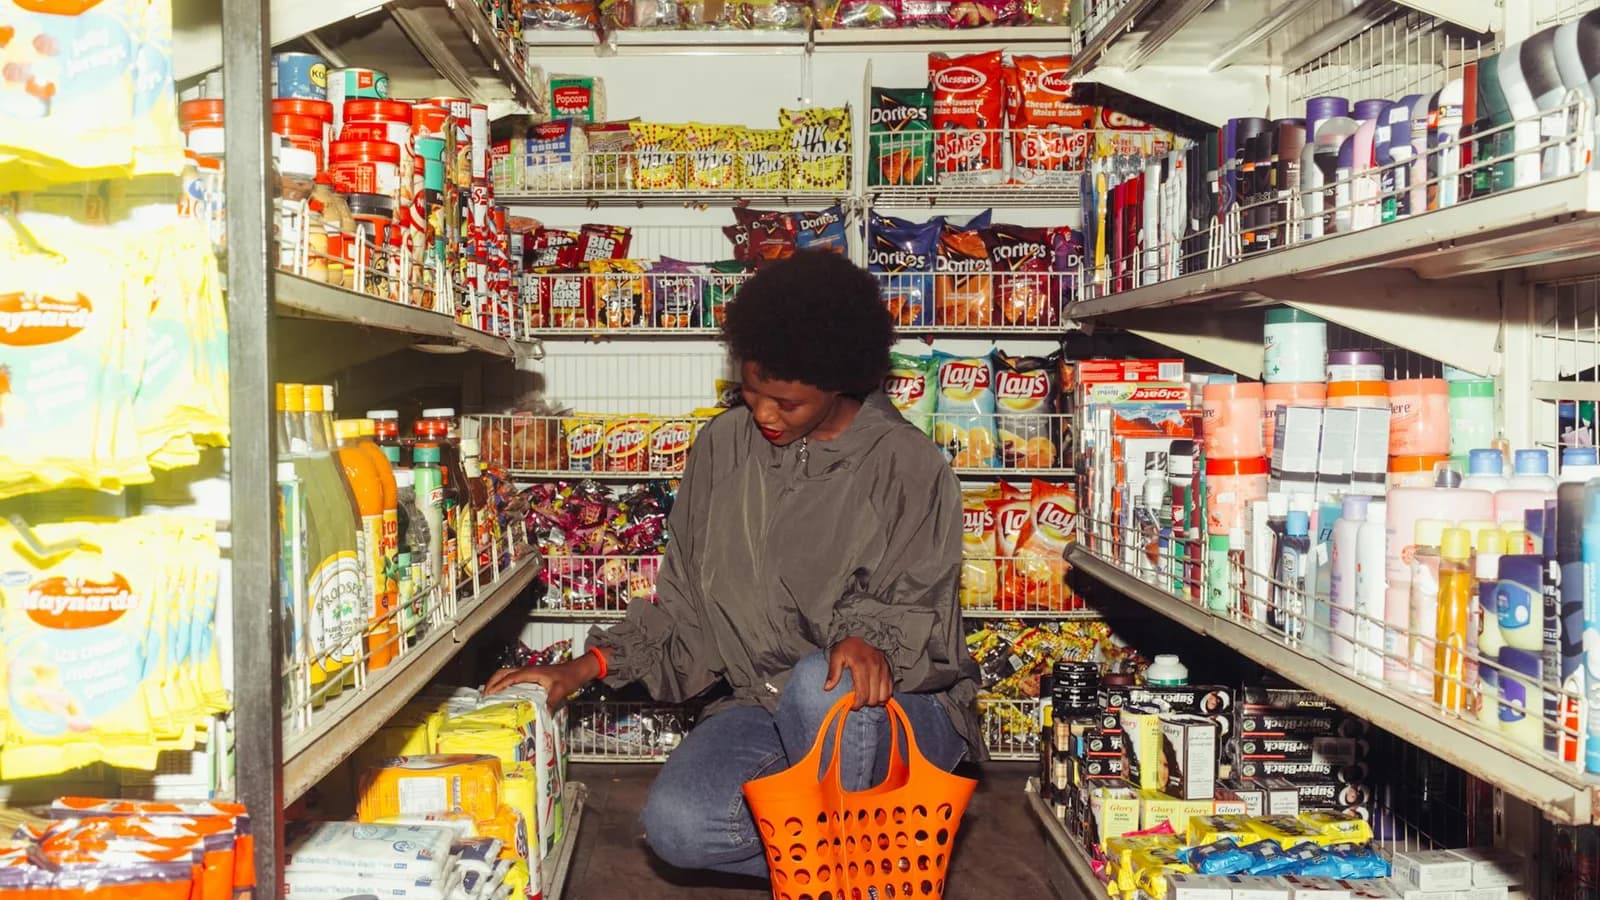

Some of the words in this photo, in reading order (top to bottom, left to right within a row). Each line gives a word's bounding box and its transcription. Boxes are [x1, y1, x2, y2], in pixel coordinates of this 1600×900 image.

[555, 94, 588, 105] Popcorn
[871, 106, 927, 124] Doritos
[792, 125, 828, 148] NIK
[801, 140, 847, 161] NAKS
[744, 153, 766, 166] NIK
[750, 157, 784, 176] NAKS
[800, 214, 839, 230] Doritos
[588, 236, 616, 249] BIG
[868, 249, 925, 268] Doritos
[993, 242, 1046, 263] Doritos
[936, 255, 991, 272] Doritos
[605, 271, 641, 282] Doritos
[555, 278, 581, 290] BIG
[659, 277, 695, 289] Doritos
[1136, 388, 1188, 400] Colgate
[607, 429, 645, 451] Fritos
[654, 429, 691, 450] Fritos
[22, 591, 139, 615] Maynards
[1263, 719, 1331, 730] SuperBlack
[1263, 741, 1311, 752] erBlack
[1263, 763, 1331, 775] SuperBlack
[1300, 786, 1335, 797] Super
[1110, 804, 1134, 813] Glory
[1151, 806, 1175, 814] Glory
[1184, 807, 1208, 815] Glory
[1218, 806, 1241, 814] Glory
